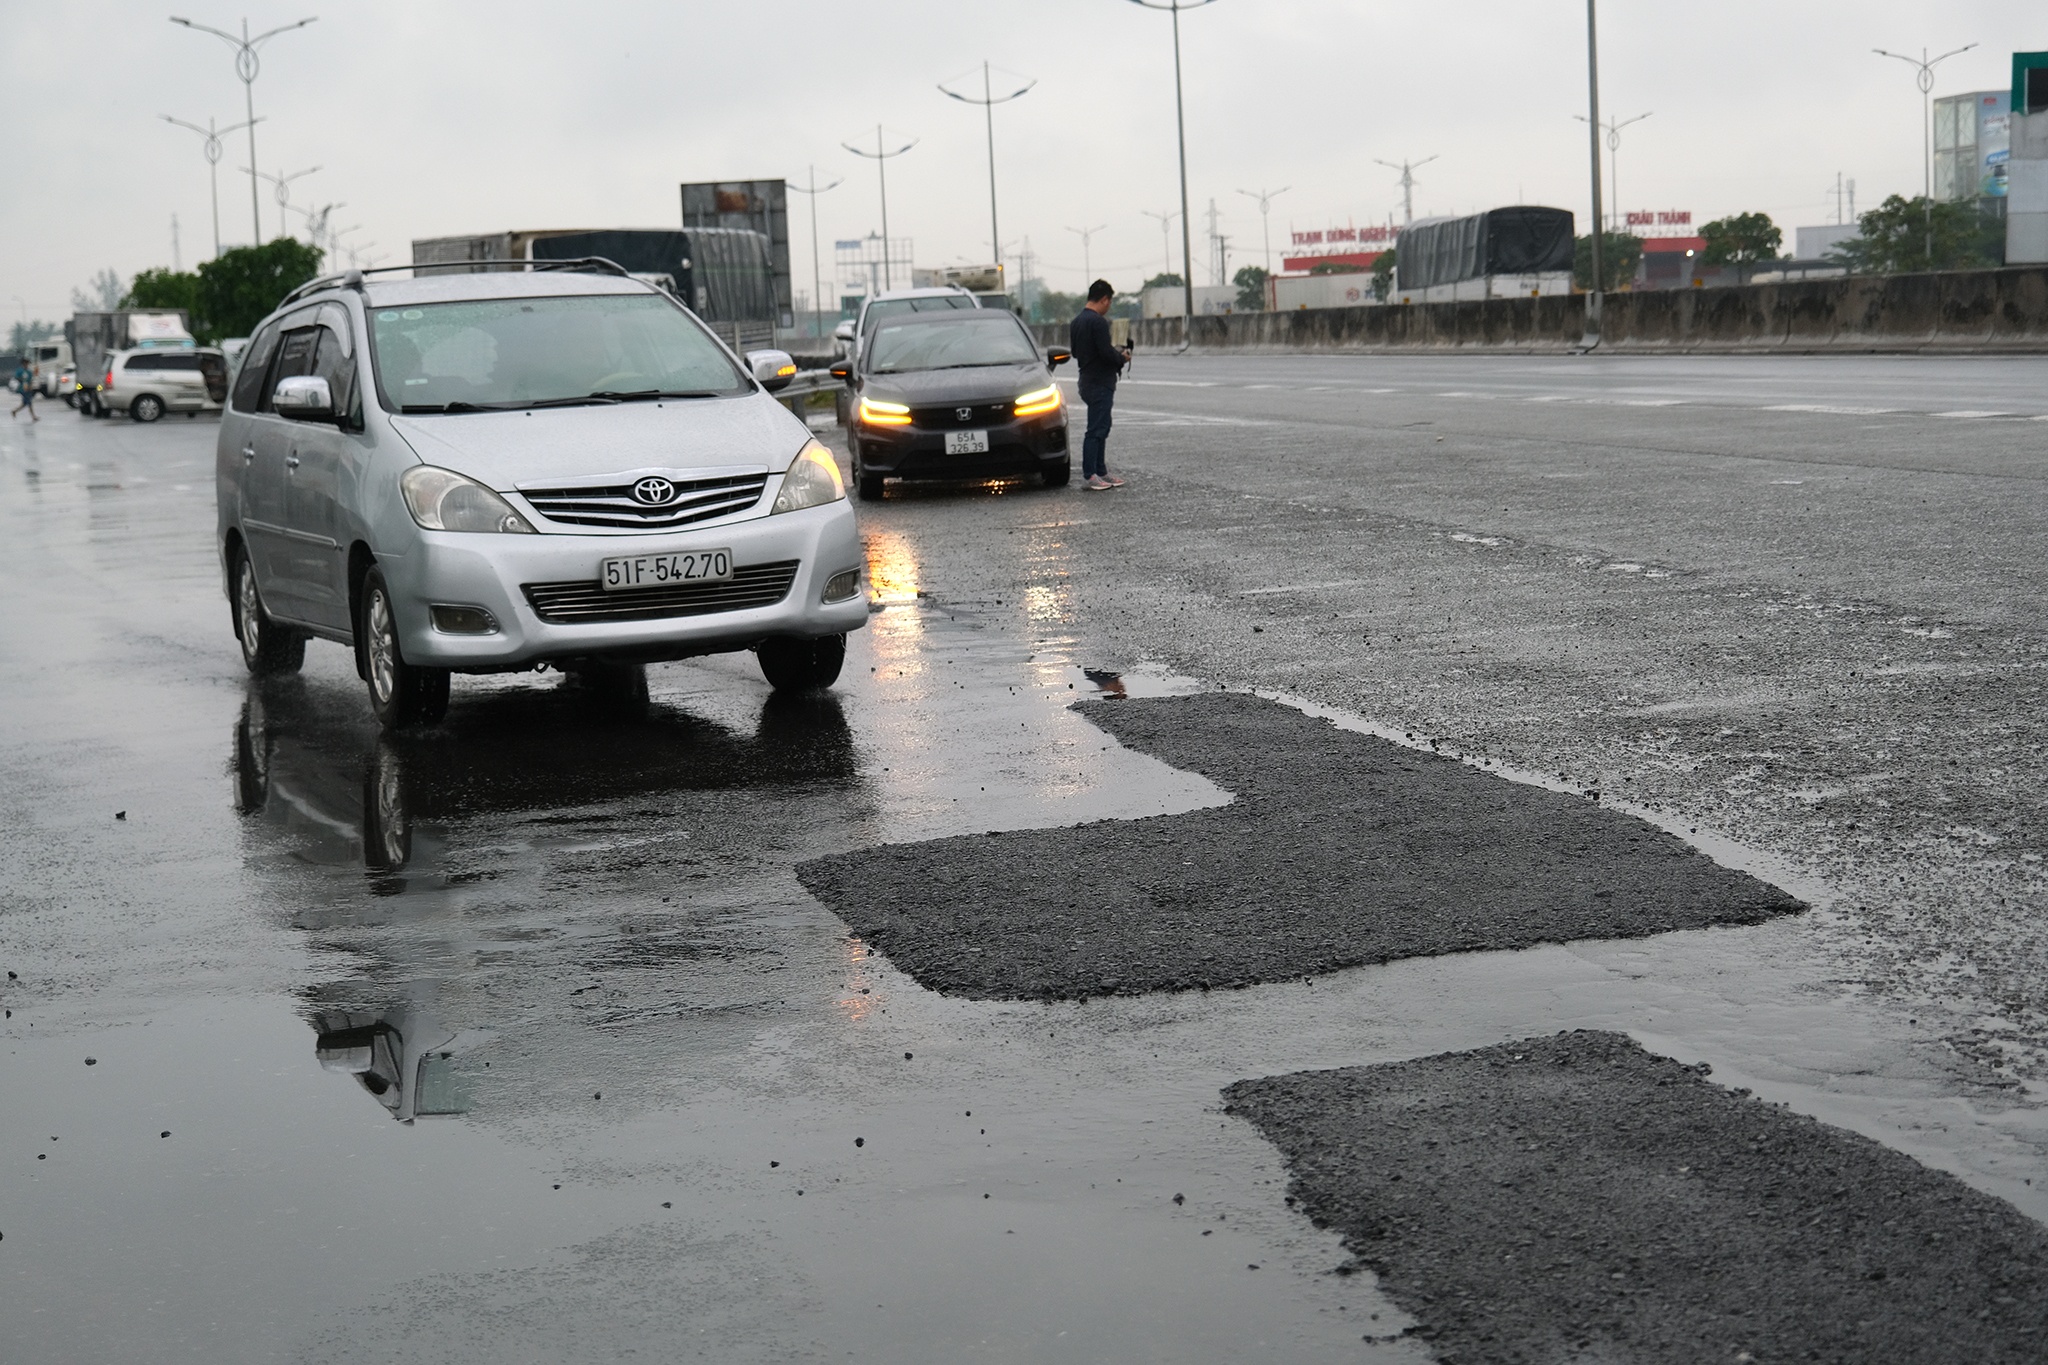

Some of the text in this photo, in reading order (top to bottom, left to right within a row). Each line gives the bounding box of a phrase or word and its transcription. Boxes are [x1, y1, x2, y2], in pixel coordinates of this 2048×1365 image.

[957, 432, 976, 443] 65A
[950, 442, 985, 454] 326.39
[606, 552, 728, 586] 51F-542.70
